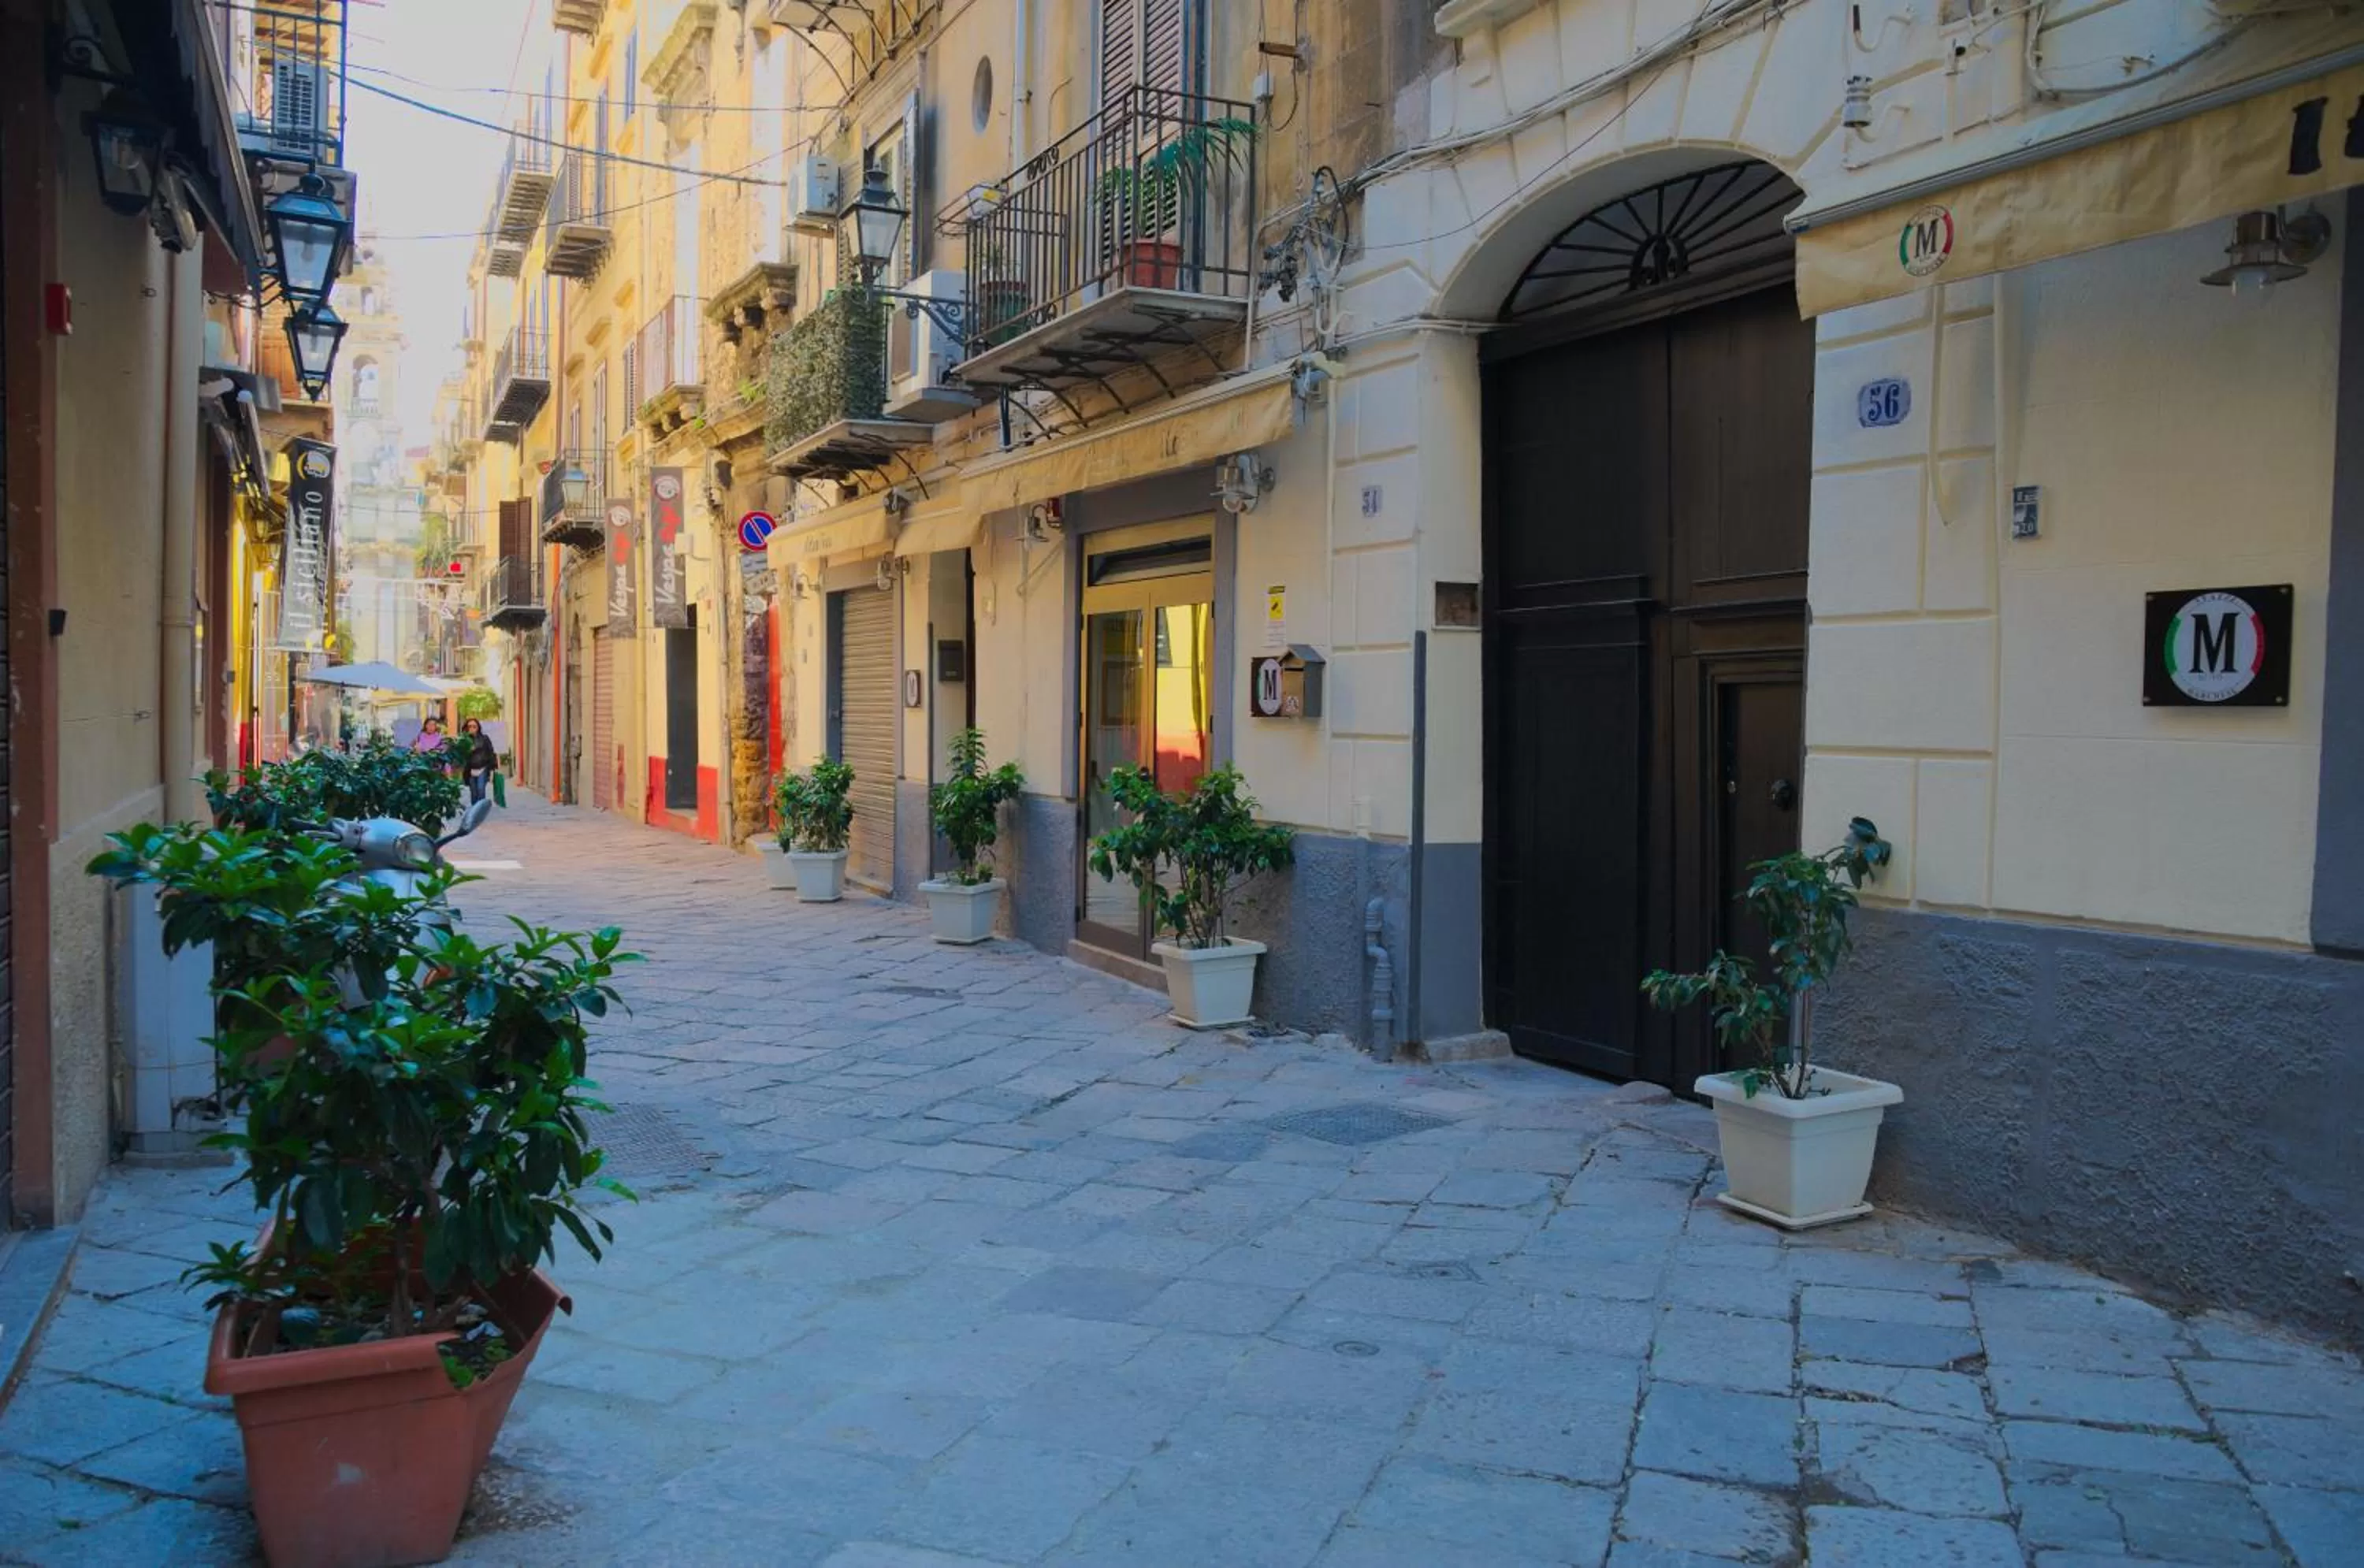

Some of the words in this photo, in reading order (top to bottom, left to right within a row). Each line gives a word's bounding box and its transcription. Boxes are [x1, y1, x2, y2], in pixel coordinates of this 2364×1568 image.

[1913, 218, 1939, 258] M
[1868, 384, 1899, 421] 56
[292, 490, 324, 604] siciliano
[2188, 612, 2240, 674] M
[1263, 670, 1277, 700] M
